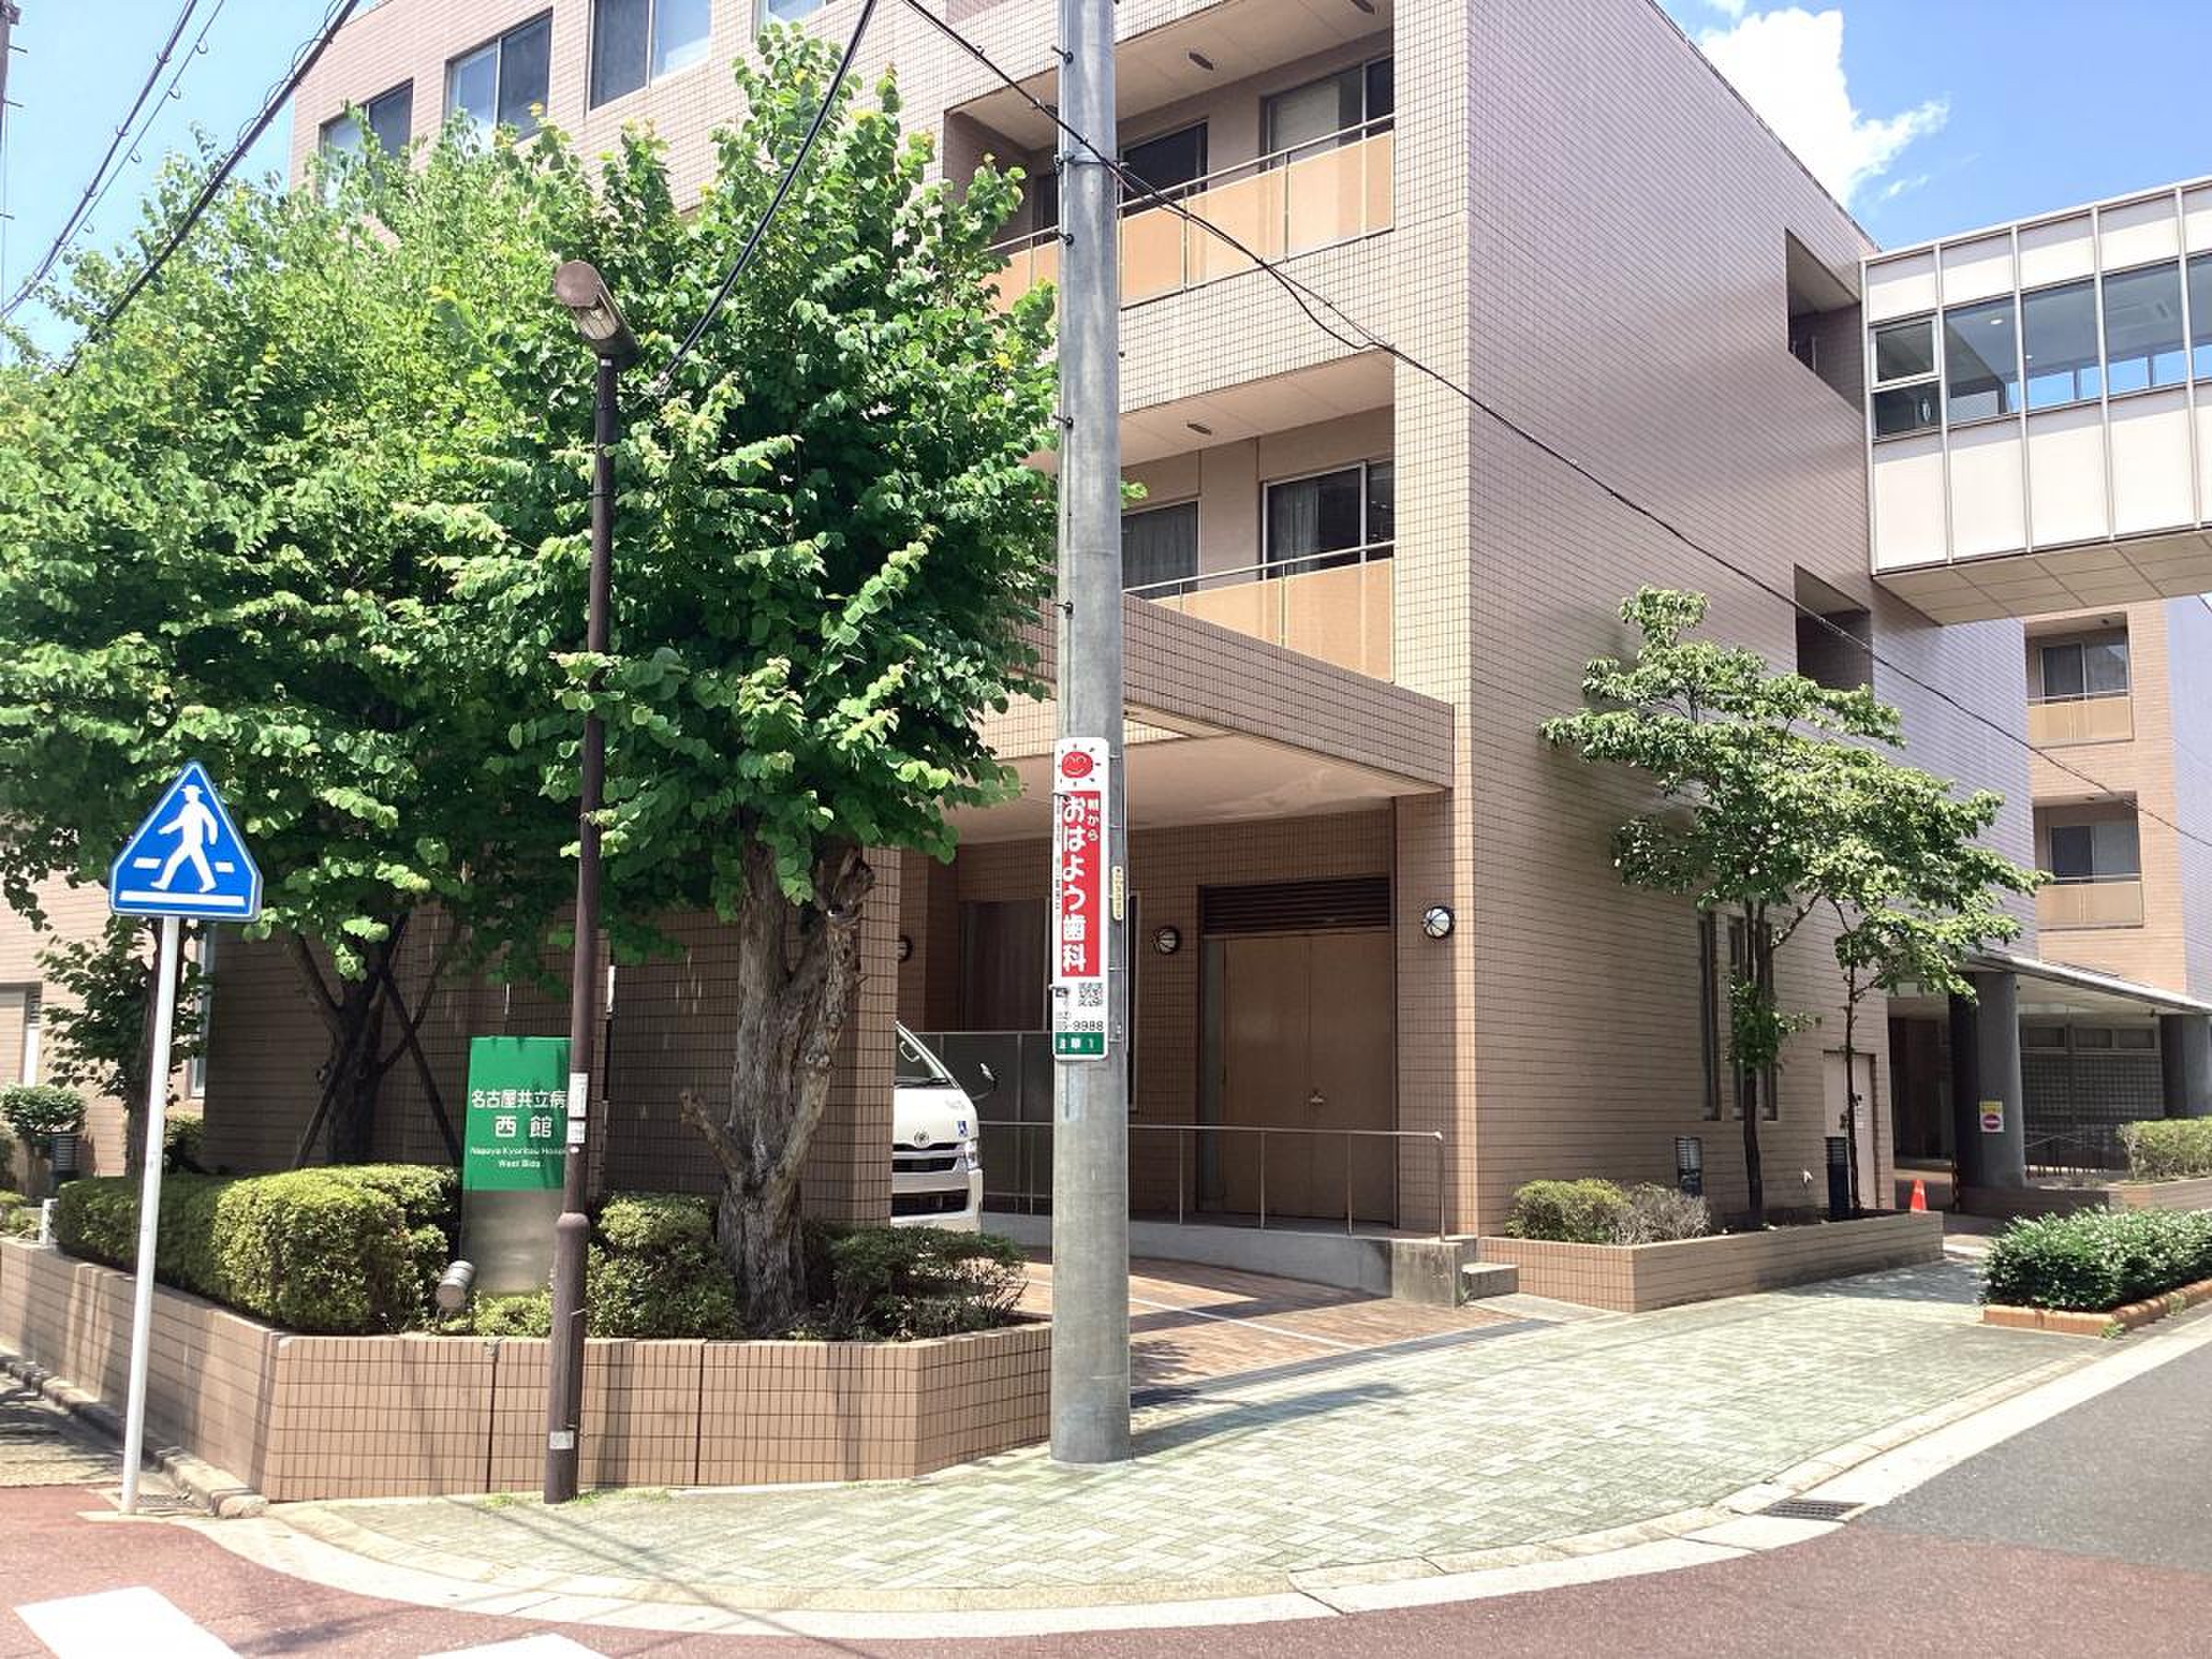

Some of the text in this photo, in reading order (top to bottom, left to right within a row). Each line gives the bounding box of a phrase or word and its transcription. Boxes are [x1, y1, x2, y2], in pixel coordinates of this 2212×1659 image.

[1063, 795, 1087, 972] おはよう歯科
[471, 1089, 567, 1109] 名古屋共立病
